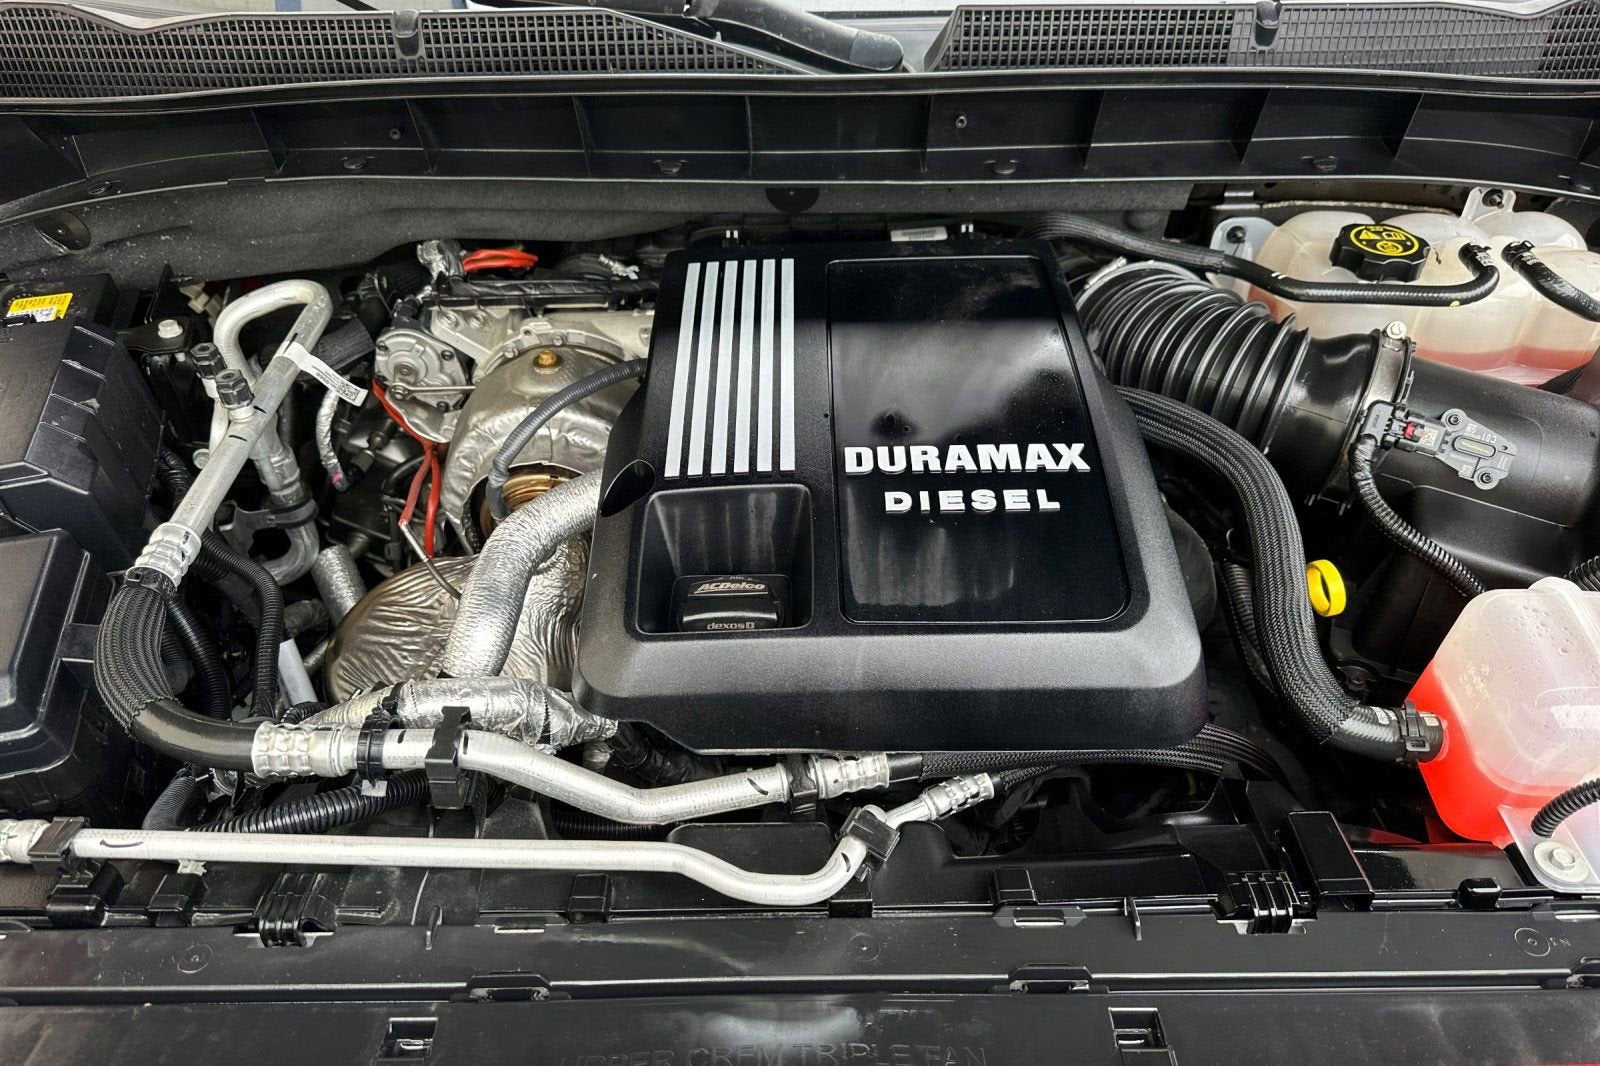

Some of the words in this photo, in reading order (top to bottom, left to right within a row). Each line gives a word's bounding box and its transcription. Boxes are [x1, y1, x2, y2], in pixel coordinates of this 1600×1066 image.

[844, 443, 1091, 475] DURAMAX
[884, 489, 1061, 513] DIESEL
[696, 582, 765, 592] ACDelco
[793, 1043, 912, 1066] TRIPLE
[919, 1046, 986, 1066] FAN
